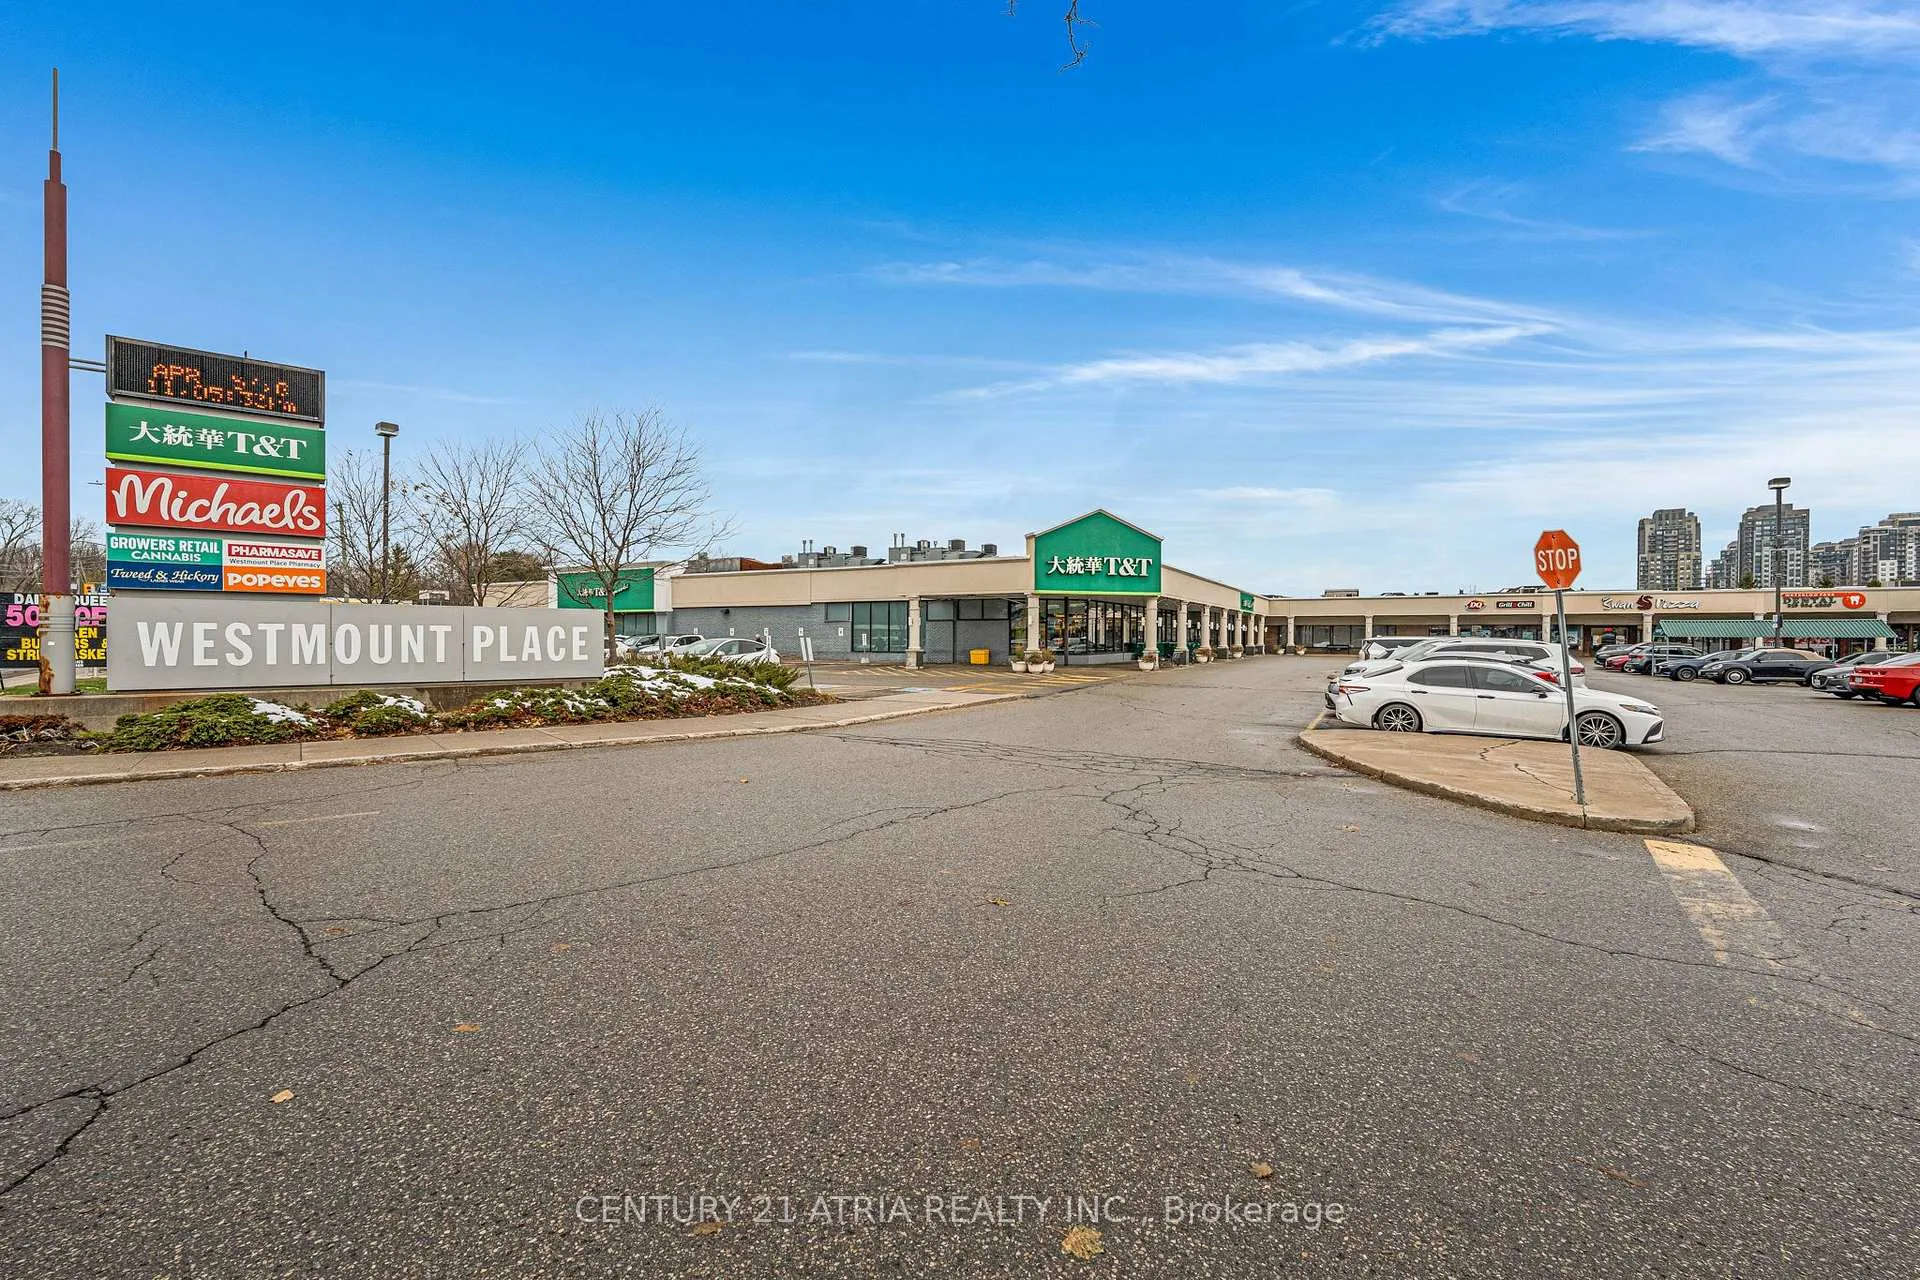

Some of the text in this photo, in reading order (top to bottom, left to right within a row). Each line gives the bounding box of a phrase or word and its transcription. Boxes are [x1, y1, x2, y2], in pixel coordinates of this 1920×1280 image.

[129, 421, 308, 460] 大統華 T&T
[111, 473, 321, 531] Michaels
[110, 536, 220, 554] GROWERS RETAIL
[231, 545, 319, 560] PHARMASAVE
[131, 550, 201, 562] CANNABIS
[229, 558, 268, 566] Westmount
[288, 561, 321, 569] Pharmacy
[1537, 548, 1578, 572] STOP
[110, 568, 219, 584] Tweed & Hickory
[1103, 557, 1153, 577] T&T
[137, 622, 588, 667] WESTMOUNT PLACE
